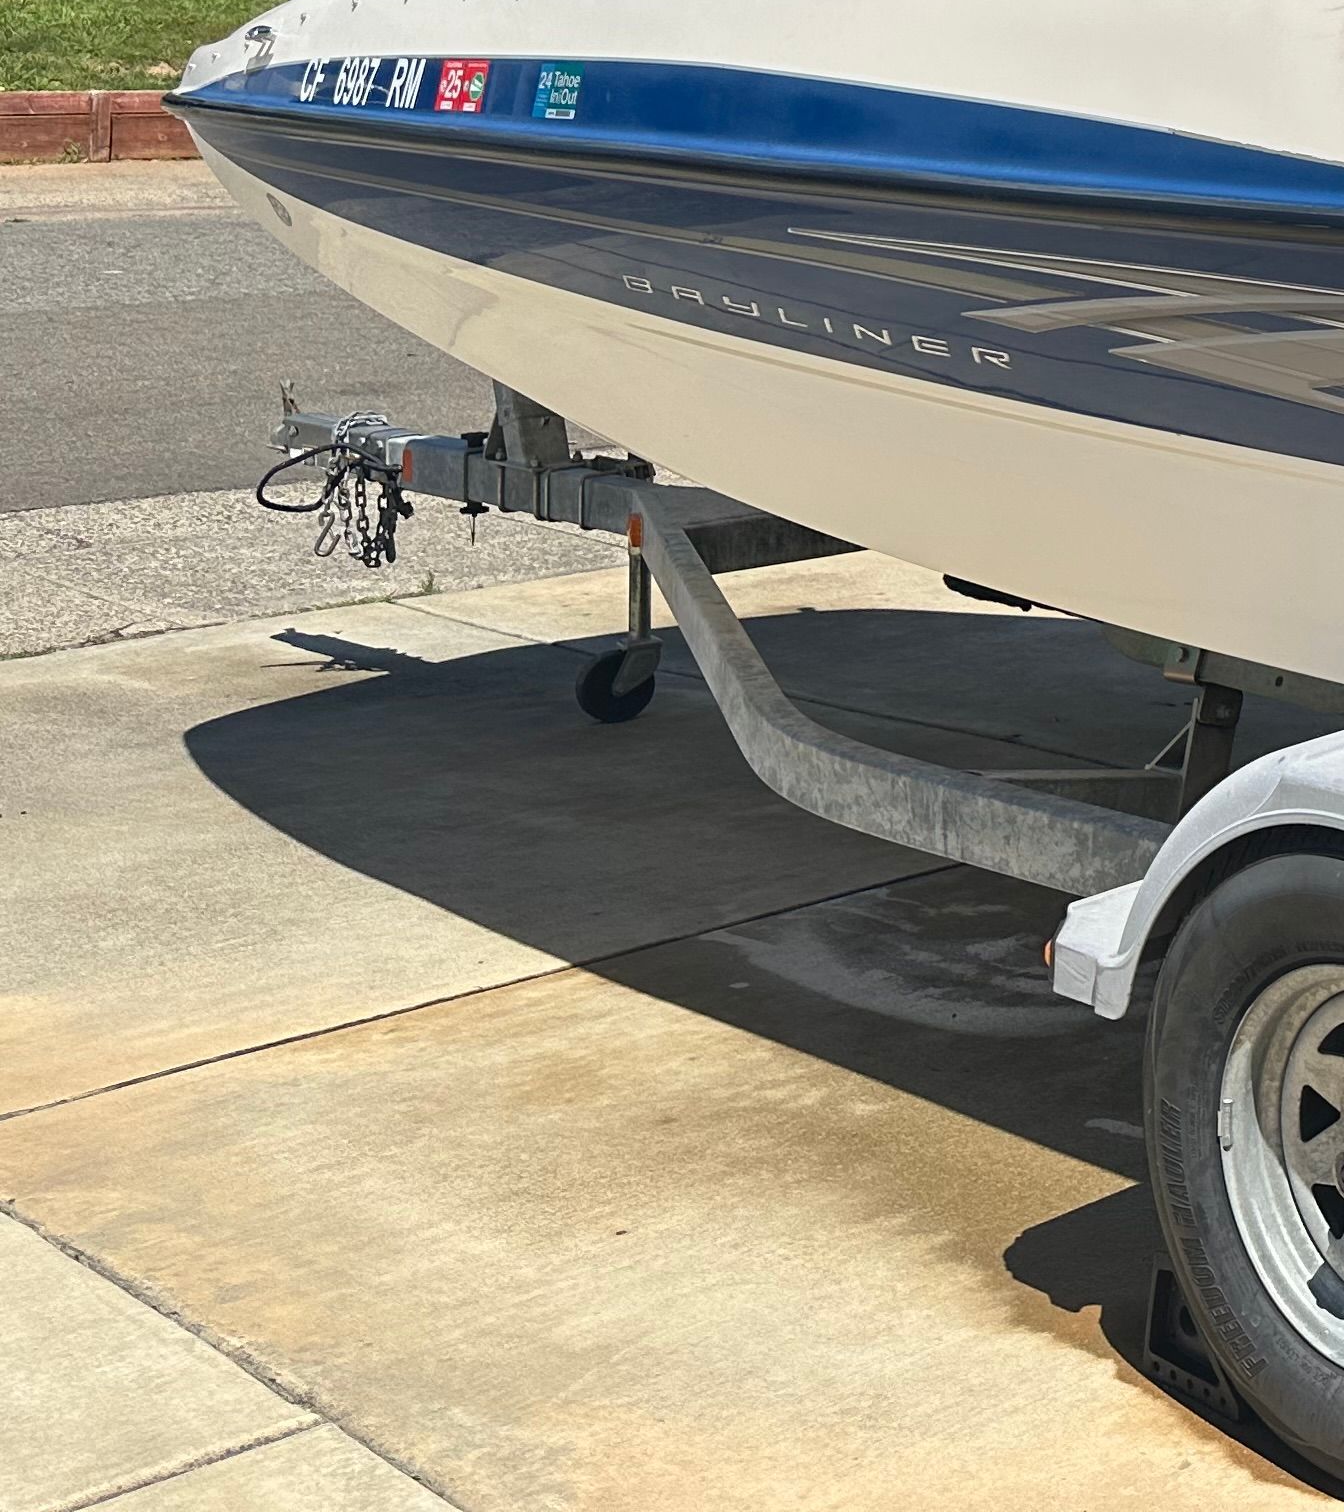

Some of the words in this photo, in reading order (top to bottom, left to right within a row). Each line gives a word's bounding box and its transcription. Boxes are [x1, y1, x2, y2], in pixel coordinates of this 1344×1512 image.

[300, 56, 330, 102] CF
[334, 56, 381, 106] 6987
[385, 58, 426, 109] RM
[443, 69, 464, 99] 25
[538, 71, 553, 89] 24
[554, 71, 581, 88] Tahoe
[622, 274, 1013, 370] BAYLINER
[1159, 1096, 1198, 1229] HAULER
[1182, 1238, 1270, 1380] FREEDOM
